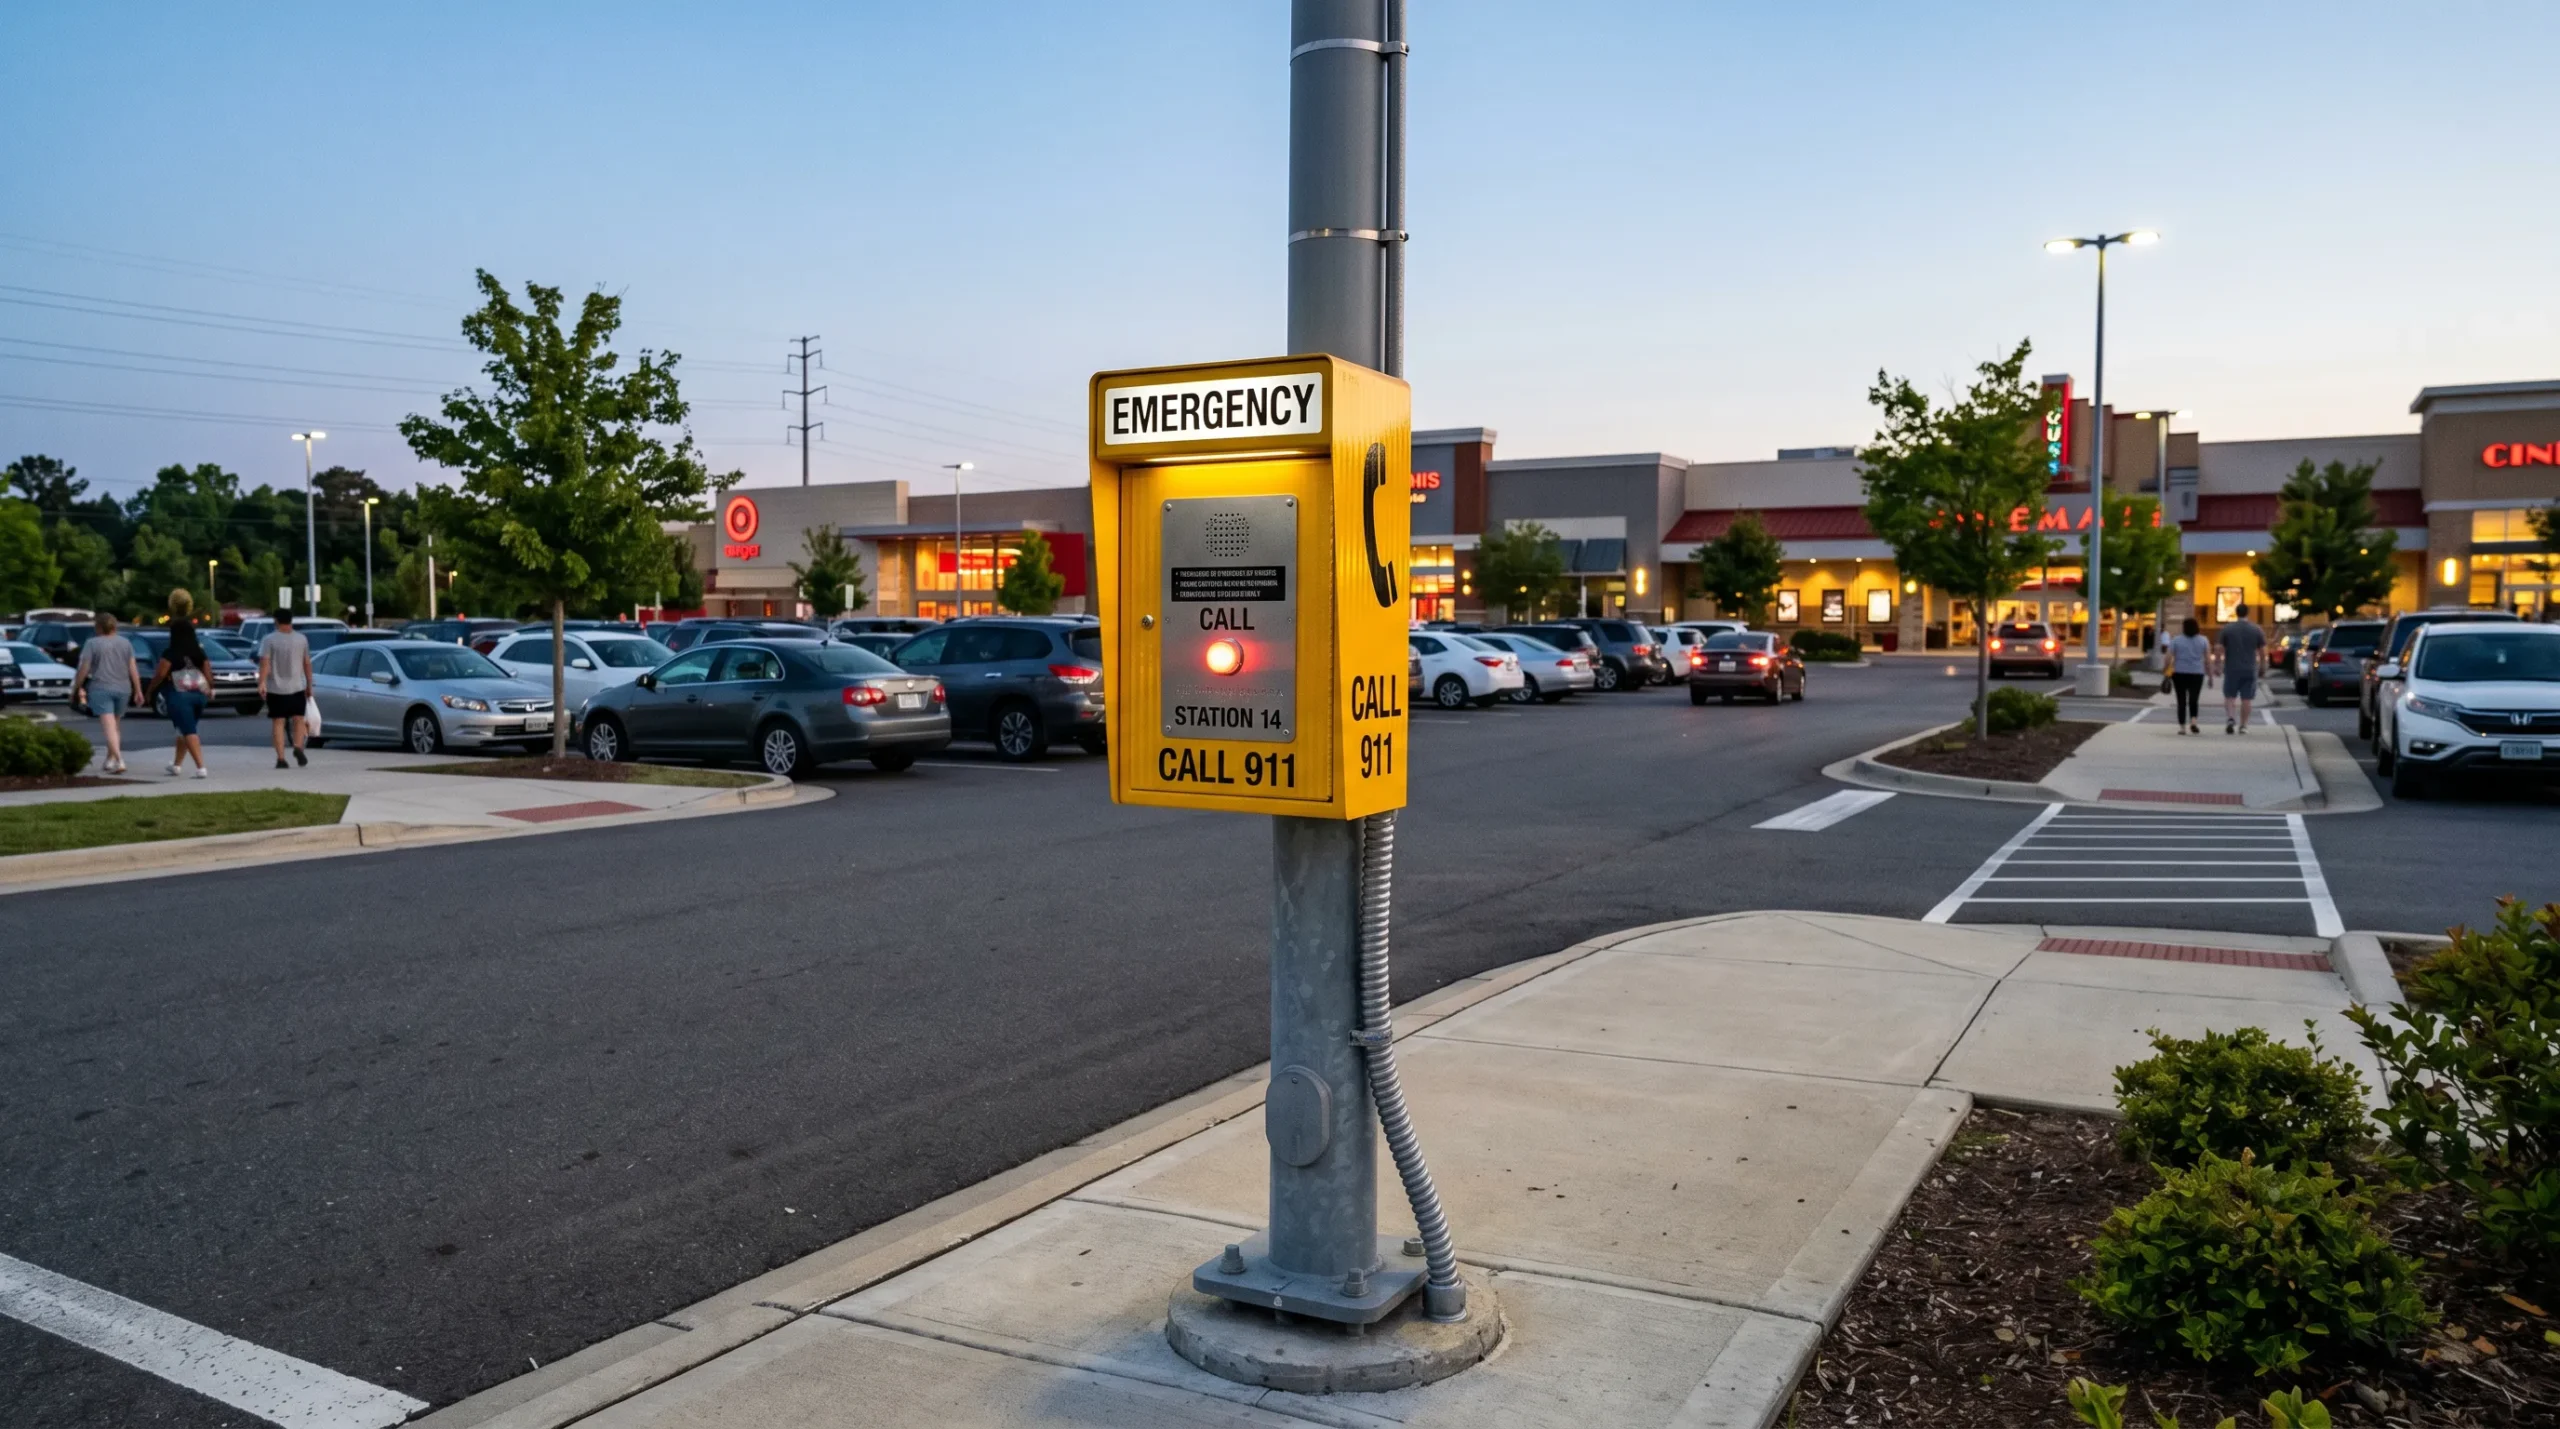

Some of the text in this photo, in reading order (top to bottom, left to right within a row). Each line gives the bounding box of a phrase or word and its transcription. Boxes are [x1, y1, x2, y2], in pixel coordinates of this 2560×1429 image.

[1113, 384, 1315, 435] EMERGENCY
[1200, 606, 1255, 631] CALL
[1174, 705, 1282, 729] STATION 14
[1351, 675, 1402, 721] CALL
[1158, 747, 1295, 788] CALL 911
[1360, 732, 1392, 778] 911
